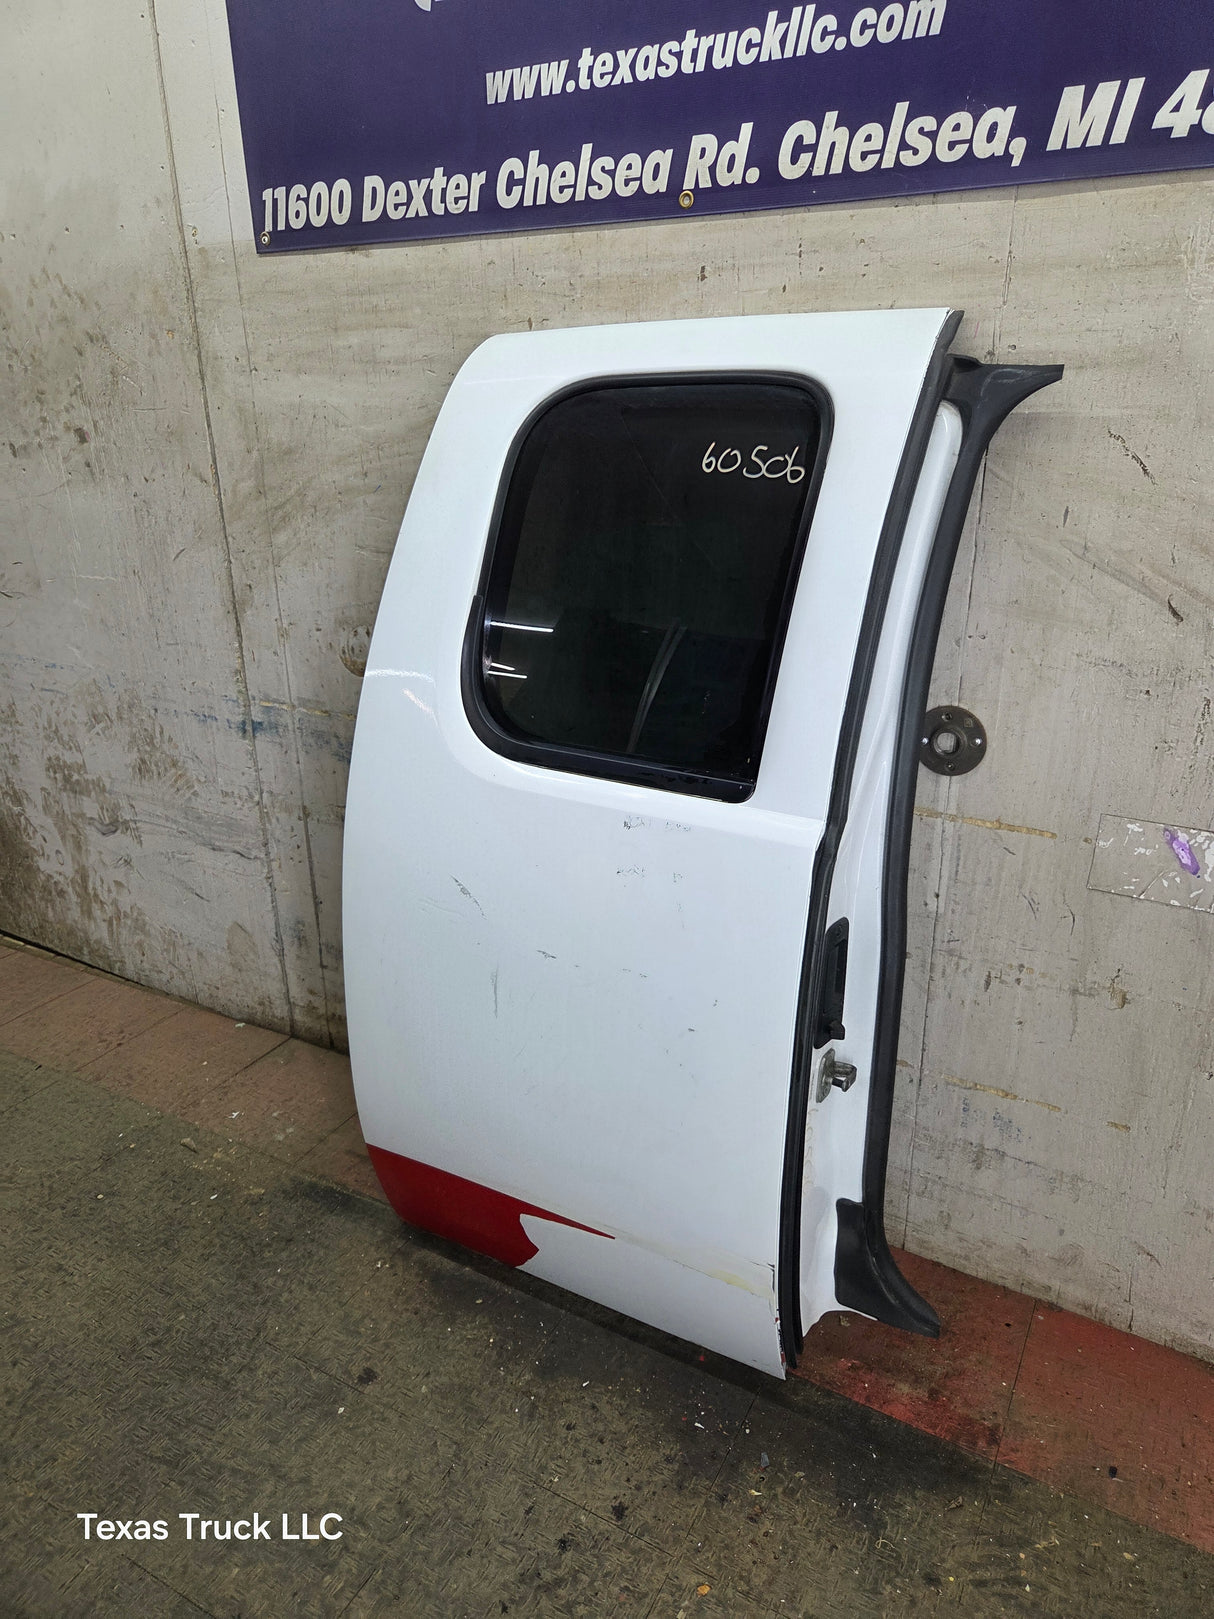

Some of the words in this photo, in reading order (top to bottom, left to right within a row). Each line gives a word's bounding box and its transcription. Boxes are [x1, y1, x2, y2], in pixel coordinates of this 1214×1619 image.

[485, 0, 946, 105] www.texastruckllc.com
[261, 178, 351, 232] 11600
[362, 167, 486, 223] Dexter
[496, 143, 674, 209] Chelsea
[682, 122, 760, 190] Rd.
[778, 101, 1028, 180] Chelsea,
[1046, 77, 1146, 151] MI
